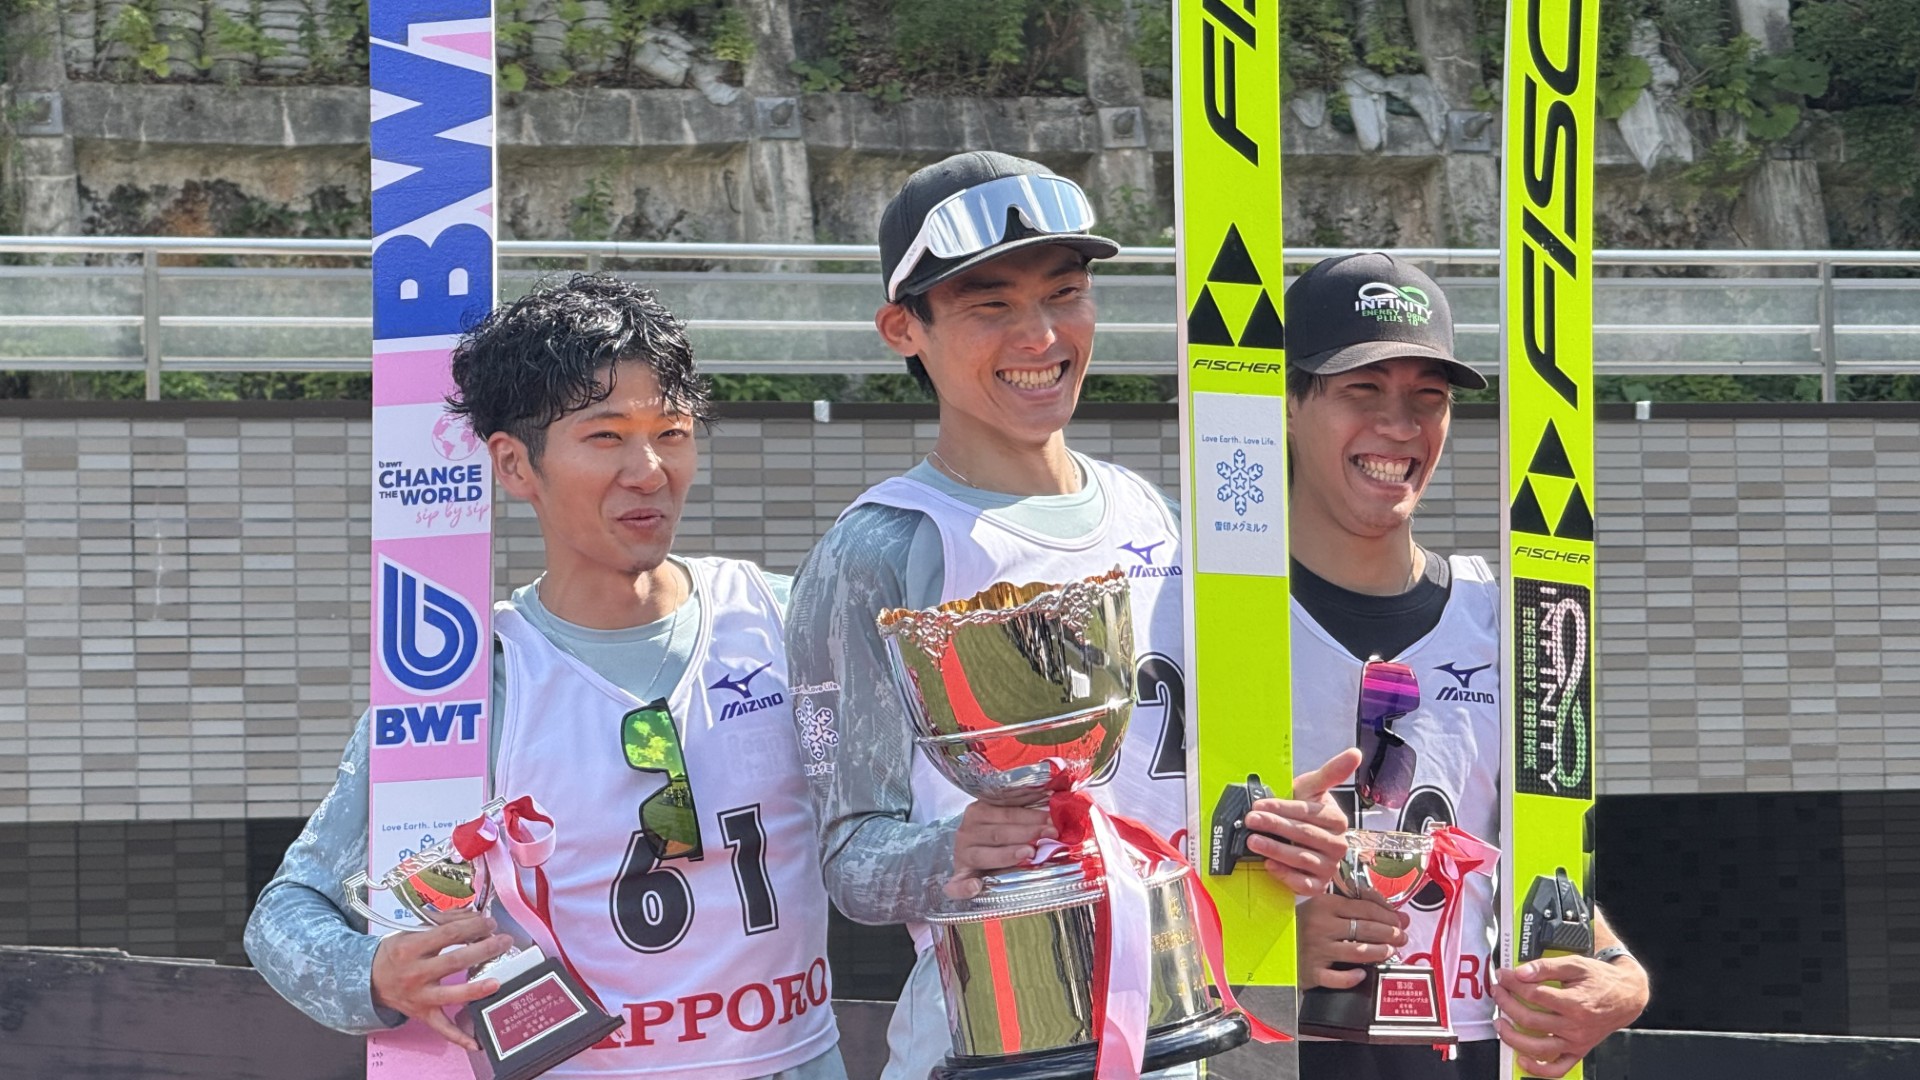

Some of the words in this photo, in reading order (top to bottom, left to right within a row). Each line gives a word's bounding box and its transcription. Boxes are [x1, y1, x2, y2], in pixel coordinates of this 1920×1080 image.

[1203, 0, 1258, 167] FI
[1355, 299, 1433, 319] INFINITY
[1193, 359, 1281, 374] FISCHER
[1220, 436, 1241, 444] Earth.
[1244, 437, 1260, 445] Love
[1262, 437, 1276, 446] Life.
[379, 464, 482, 488] CHANGE
[379, 490, 398, 499] THE
[400, 486, 482, 506] WORLD
[416, 509, 439, 528] sip
[445, 497, 462, 528] by
[467, 502, 490, 522] sip
[1215, 521, 1268, 533] 雪印メグミルク
[1515, 546, 1590, 565] FISCHER
[1128, 564, 1182, 578] MIZUNO
[1523, 607, 1537, 692] ENERGY
[1436, 687, 1495, 704] MIZUNO
[1540, 587, 1557, 792] INFINITY
[719, 692, 784, 721] MIZUNO
[376, 703, 482, 745] BWT
[404, 822, 430, 830] Earth.
[433, 821, 453, 829] Love
[610, 803, 779, 954] 61
[1521, 913, 1534, 958] Slatnar.
[510, 992, 537, 1013] 第2位
